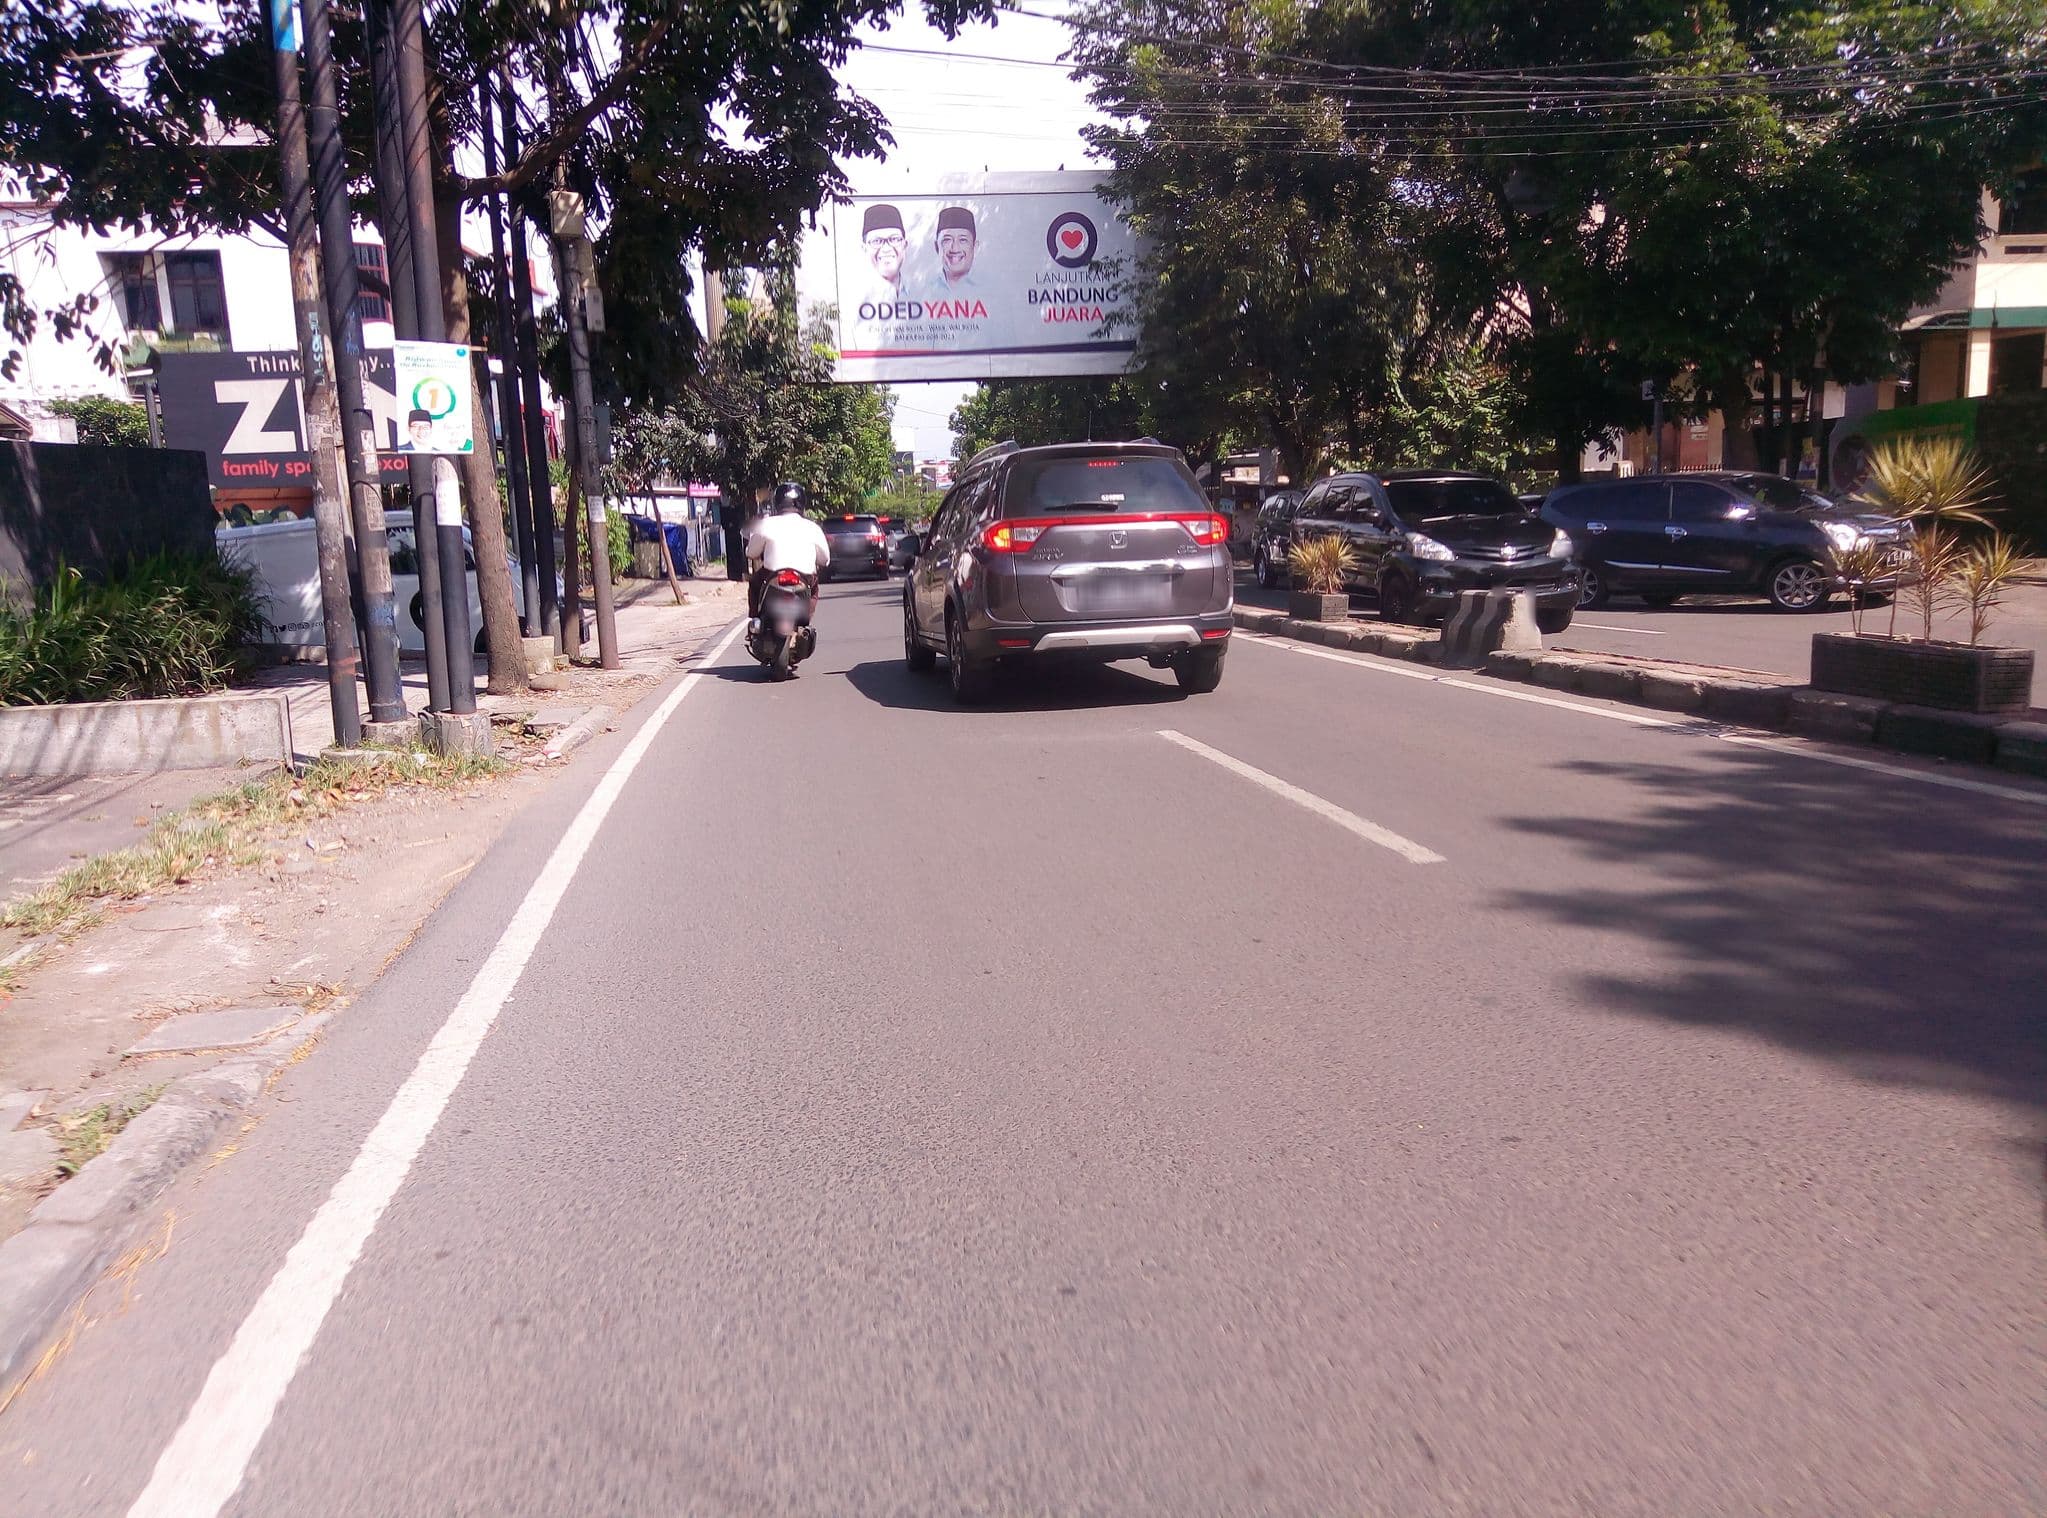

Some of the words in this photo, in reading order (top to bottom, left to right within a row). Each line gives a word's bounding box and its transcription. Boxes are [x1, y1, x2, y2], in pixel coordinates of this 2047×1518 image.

[1028, 287, 1119, 304] BANDUNG
[1044, 306, 1104, 323] JUARA
[428, 388, 439, 409] 1
[223, 459, 279, 479] family
